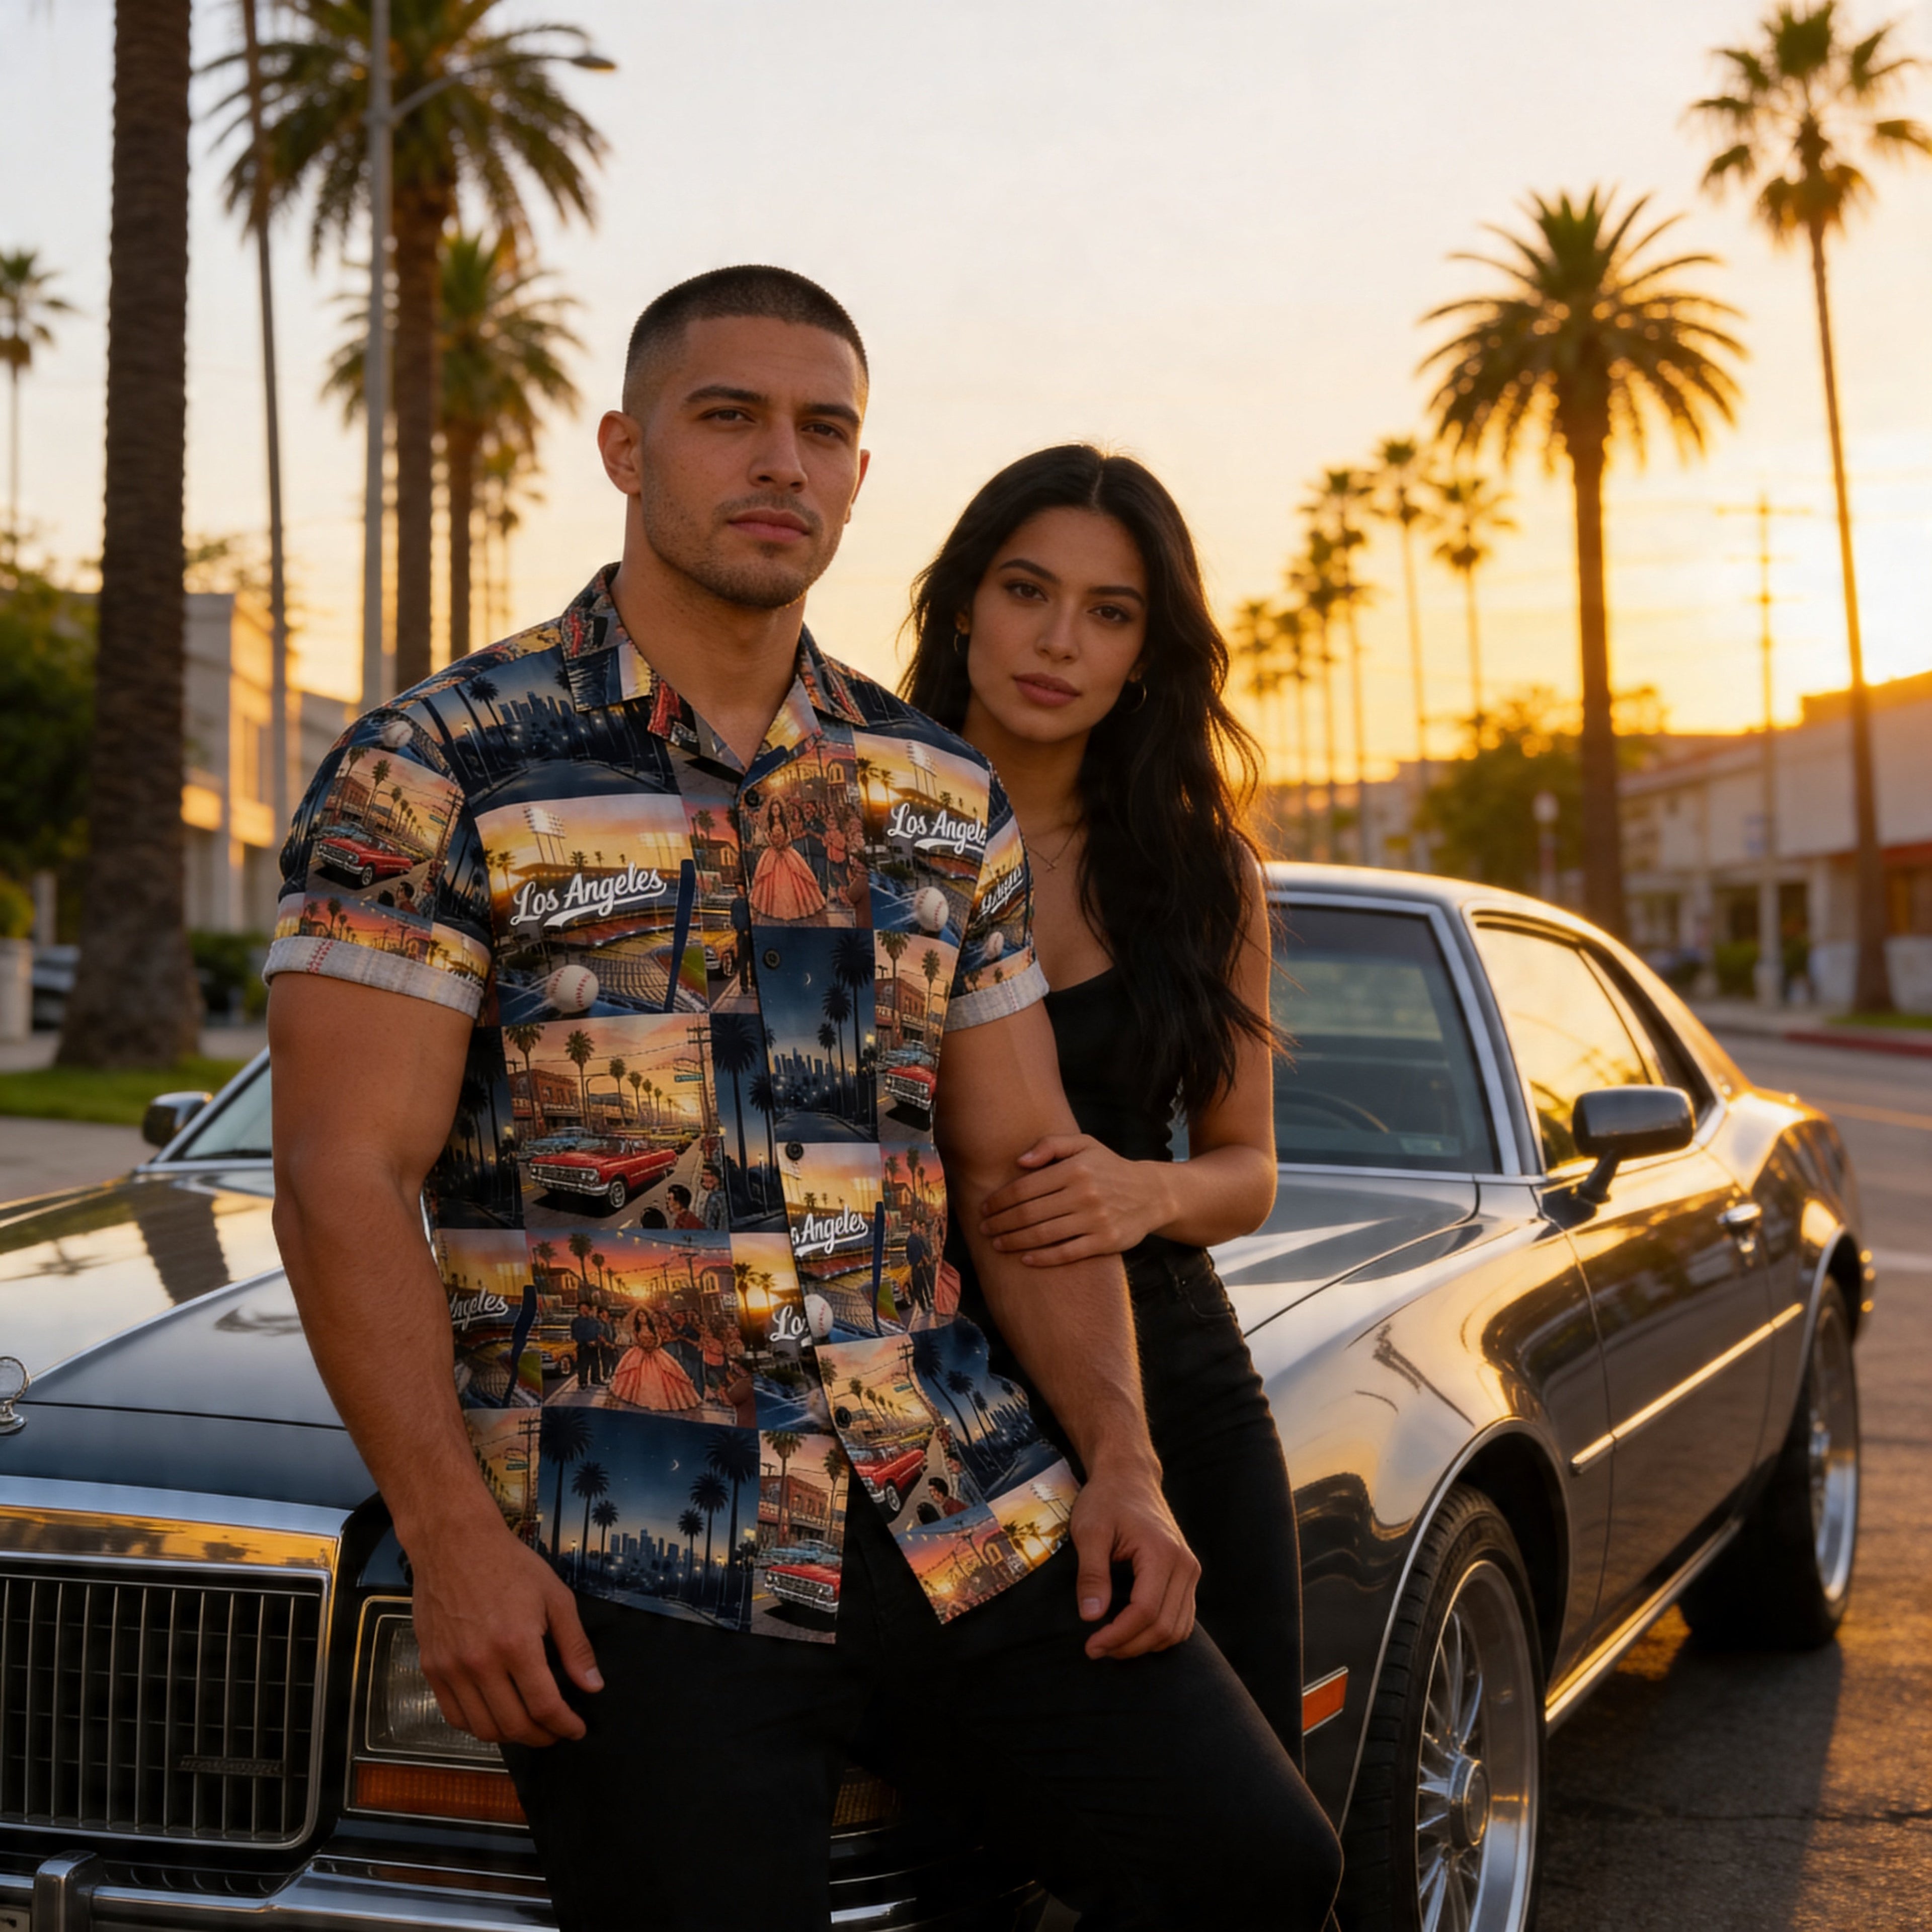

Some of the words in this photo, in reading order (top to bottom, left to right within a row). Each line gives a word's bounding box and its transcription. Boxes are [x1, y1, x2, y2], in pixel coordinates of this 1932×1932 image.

[887, 803, 927, 839] Los
[510, 881, 559, 926] Los
[562, 861, 667, 916] Angeles
[800, 1204, 868, 1254] Angeles
[769, 1305, 809, 1342] Lo
